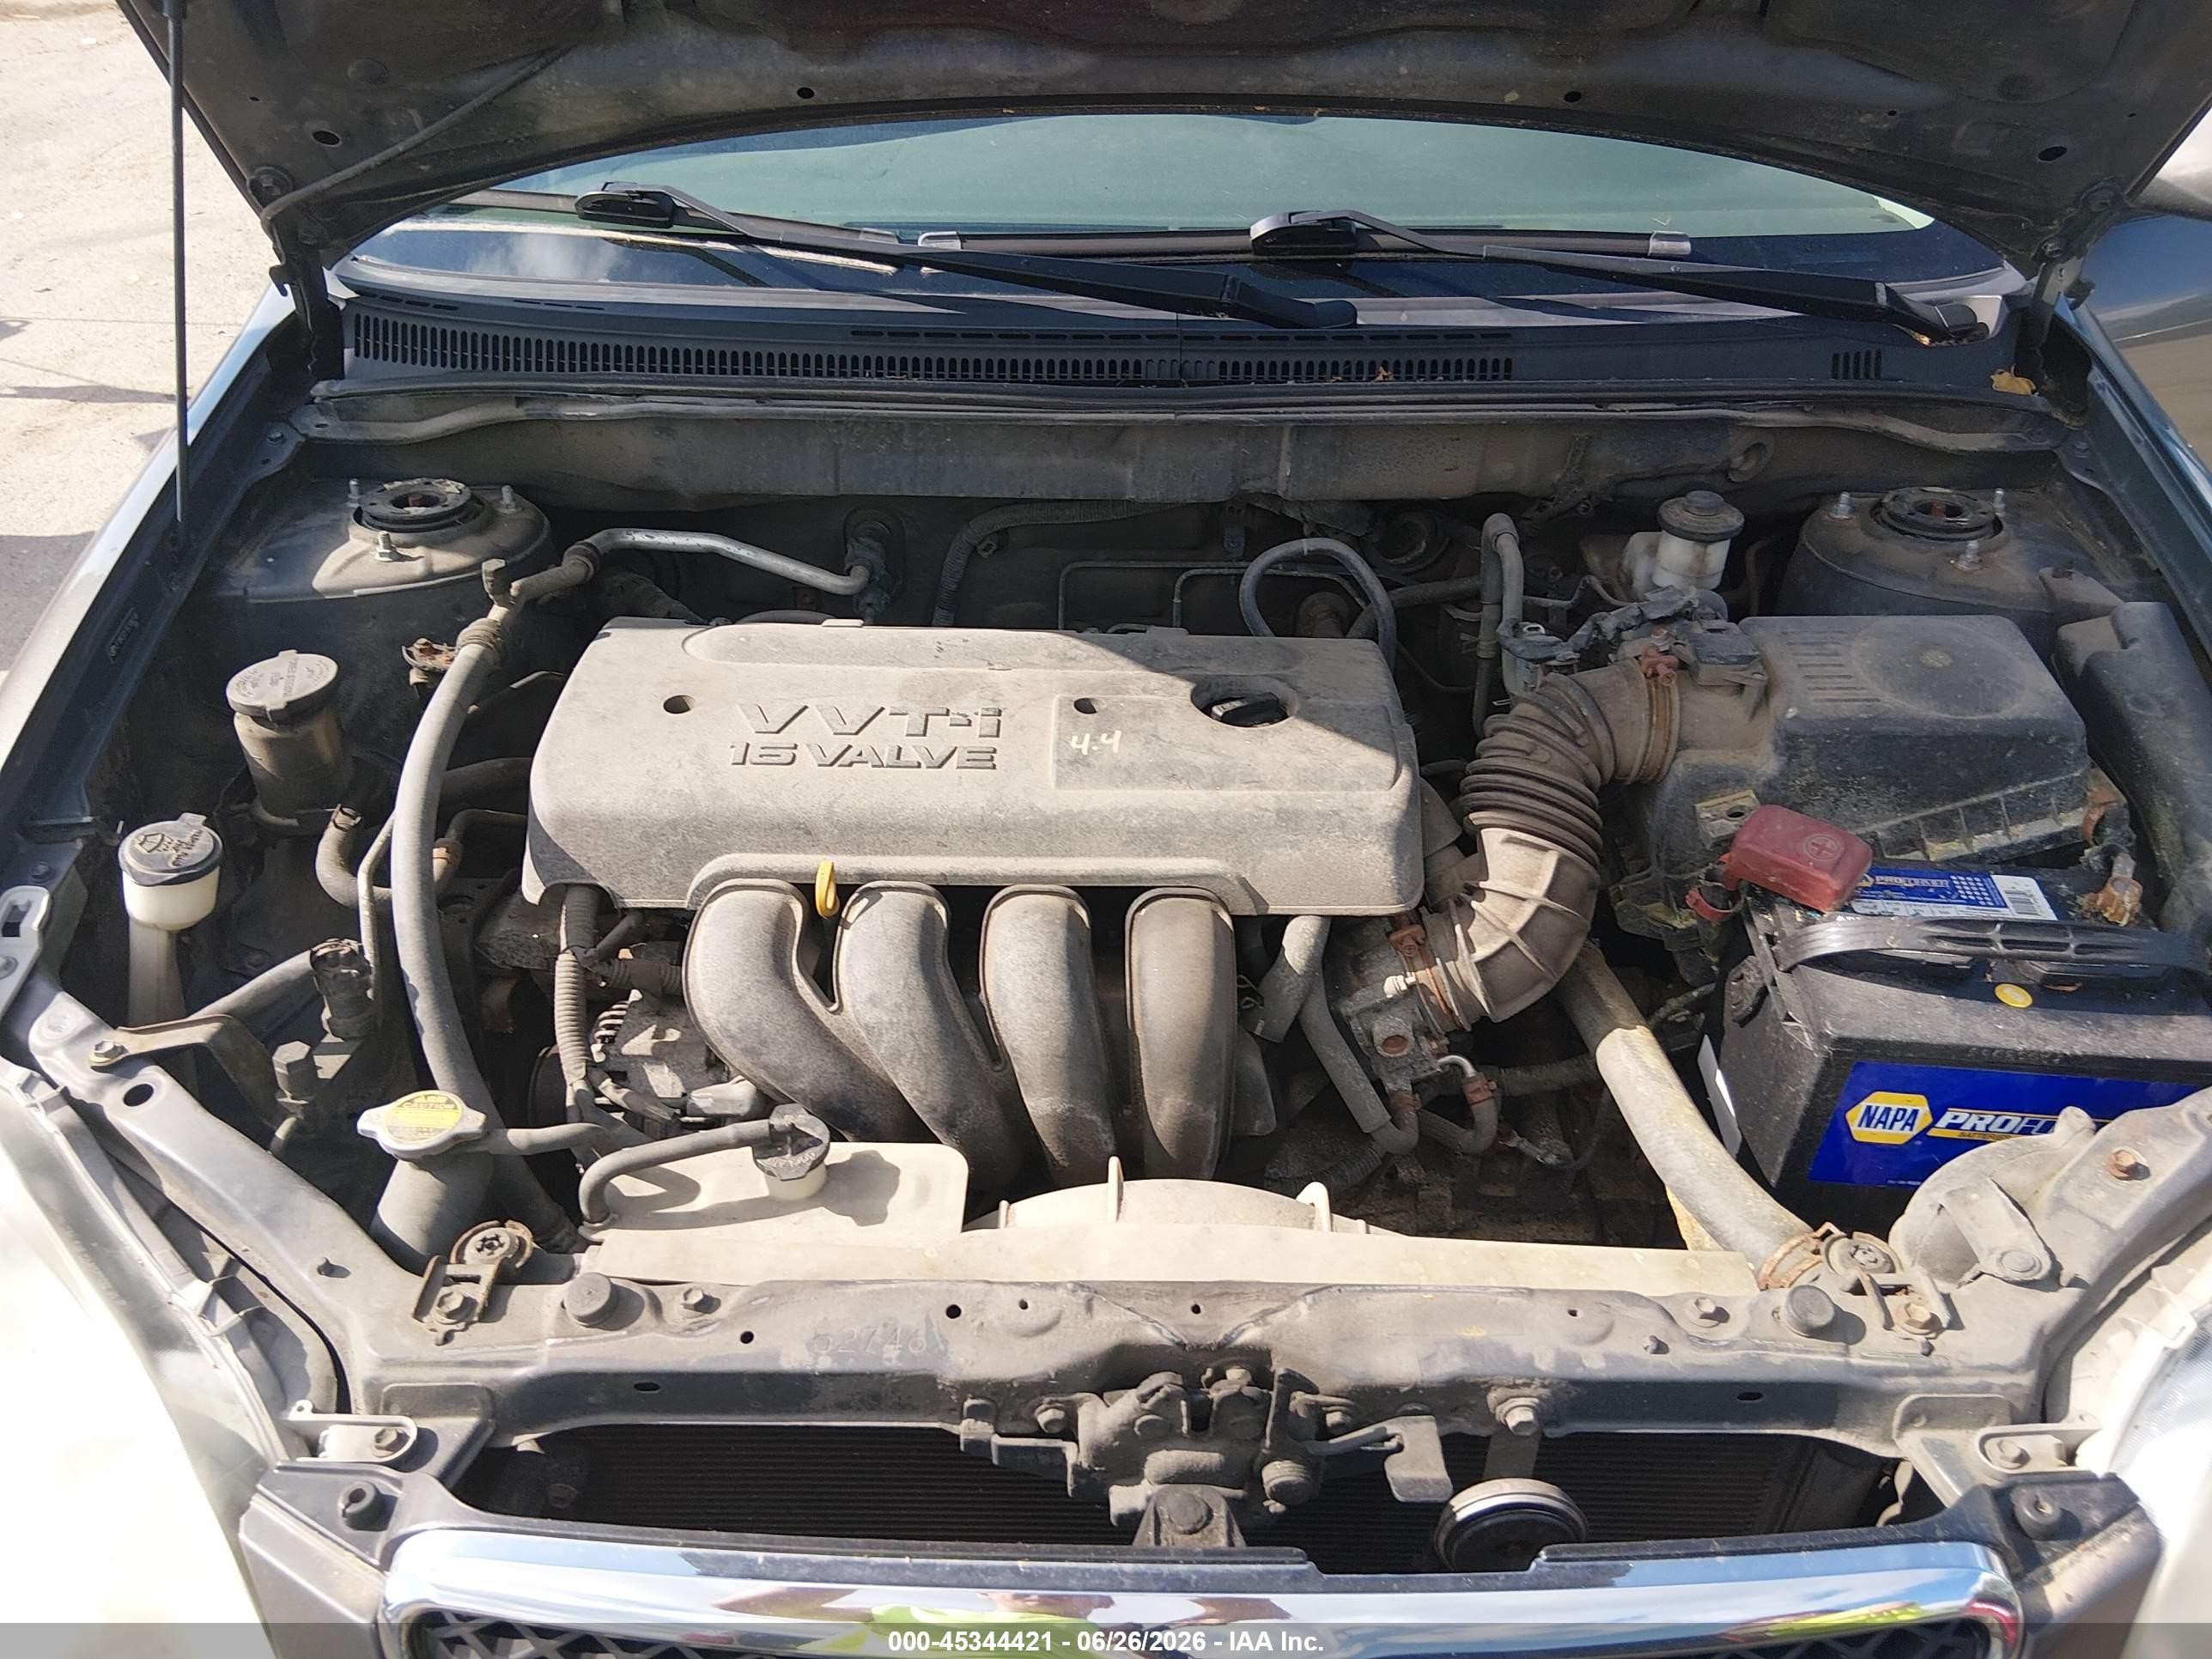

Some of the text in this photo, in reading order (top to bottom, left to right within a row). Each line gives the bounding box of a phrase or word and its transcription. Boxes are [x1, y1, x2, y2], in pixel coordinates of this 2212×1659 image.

[730, 742, 998, 769] 16 VALVE
[1070, 730, 1122, 756] 4.4
[1857, 1104, 1920, 1133] NAPA
[1935, 1111, 2057, 1134] PROFO
